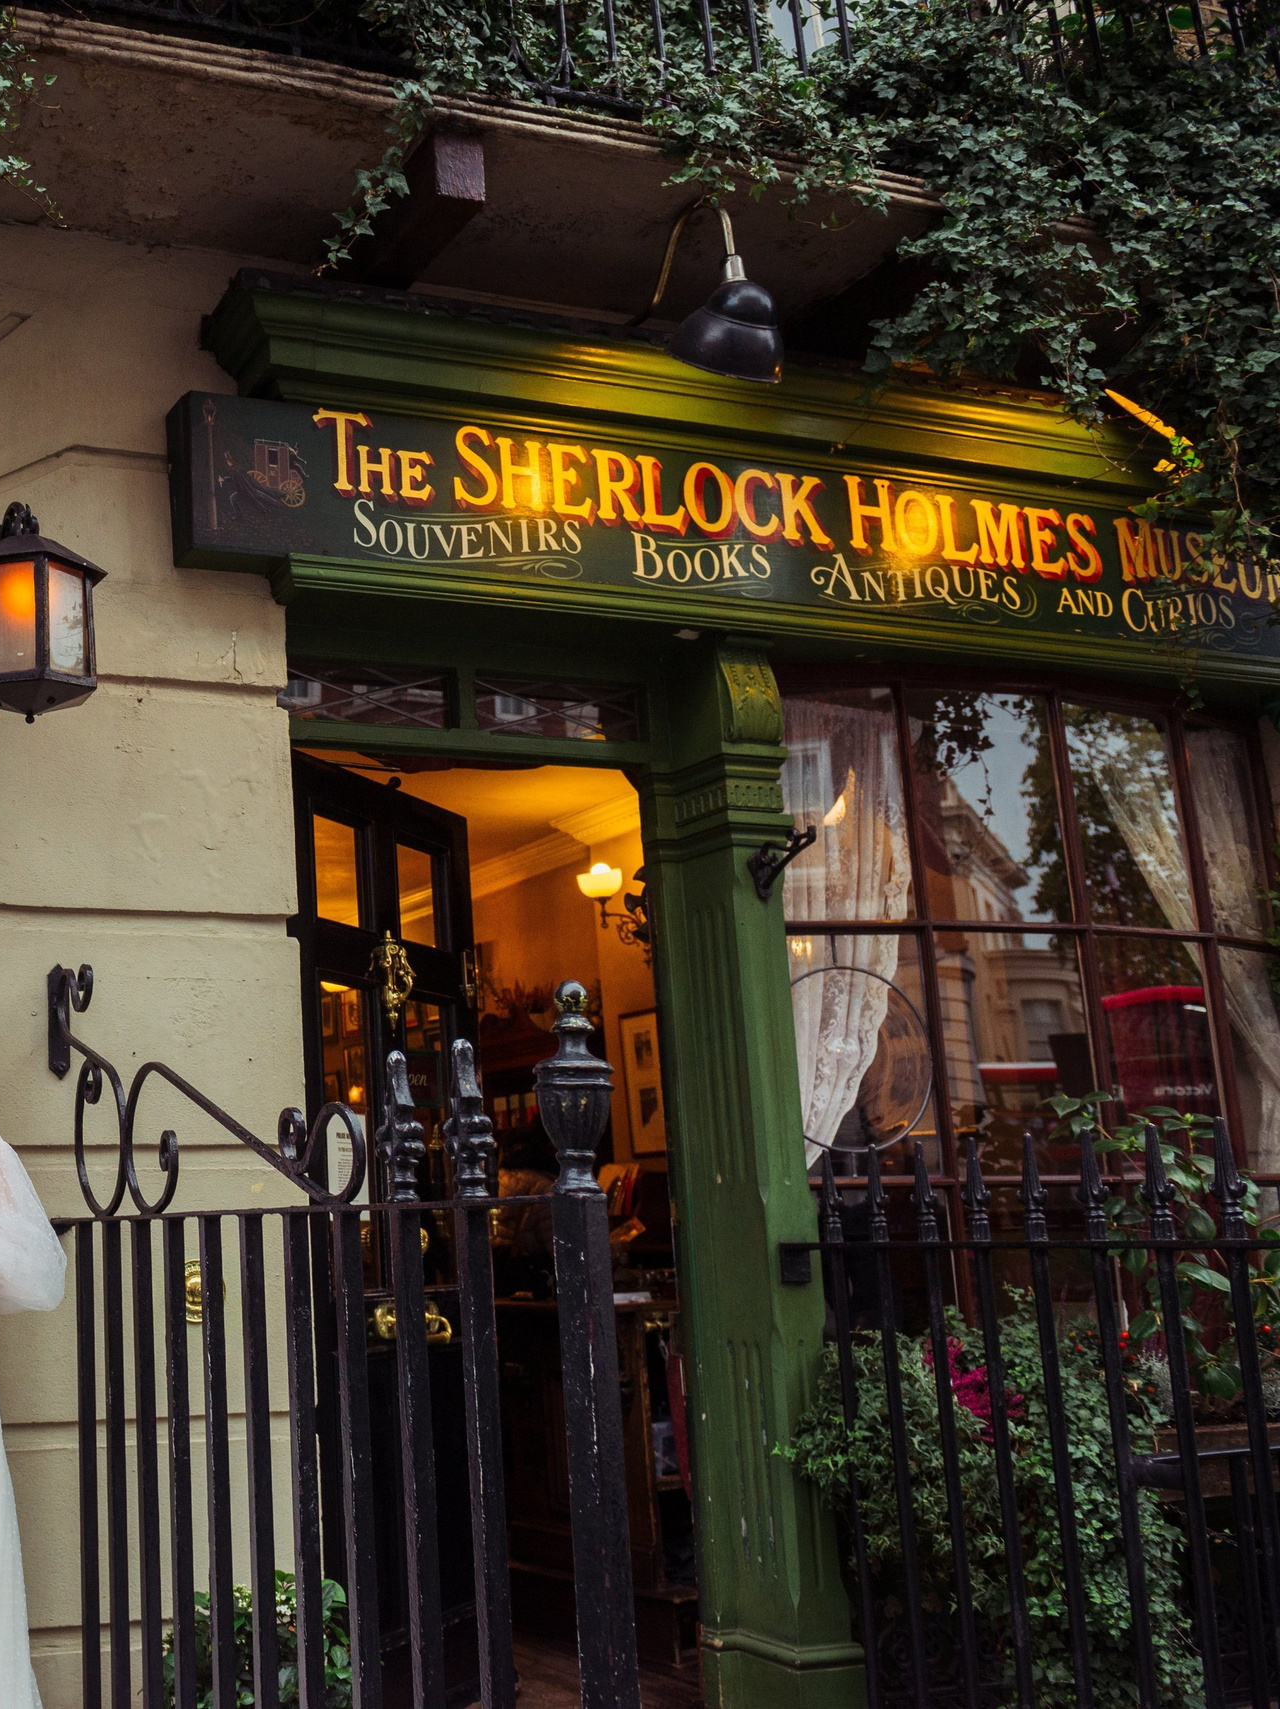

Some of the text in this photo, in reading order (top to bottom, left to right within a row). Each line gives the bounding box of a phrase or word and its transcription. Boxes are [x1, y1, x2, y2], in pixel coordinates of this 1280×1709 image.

[354, 499, 582, 559] SOUVENIRS
[631, 531, 771, 583] BOOKS
[811, 553, 1021, 610] ANTIQUES
[1057, 587, 1113, 618] AND
[454, 426, 835, 551] SHERLOCK
[843, 475, 1103, 583] HOLMES
